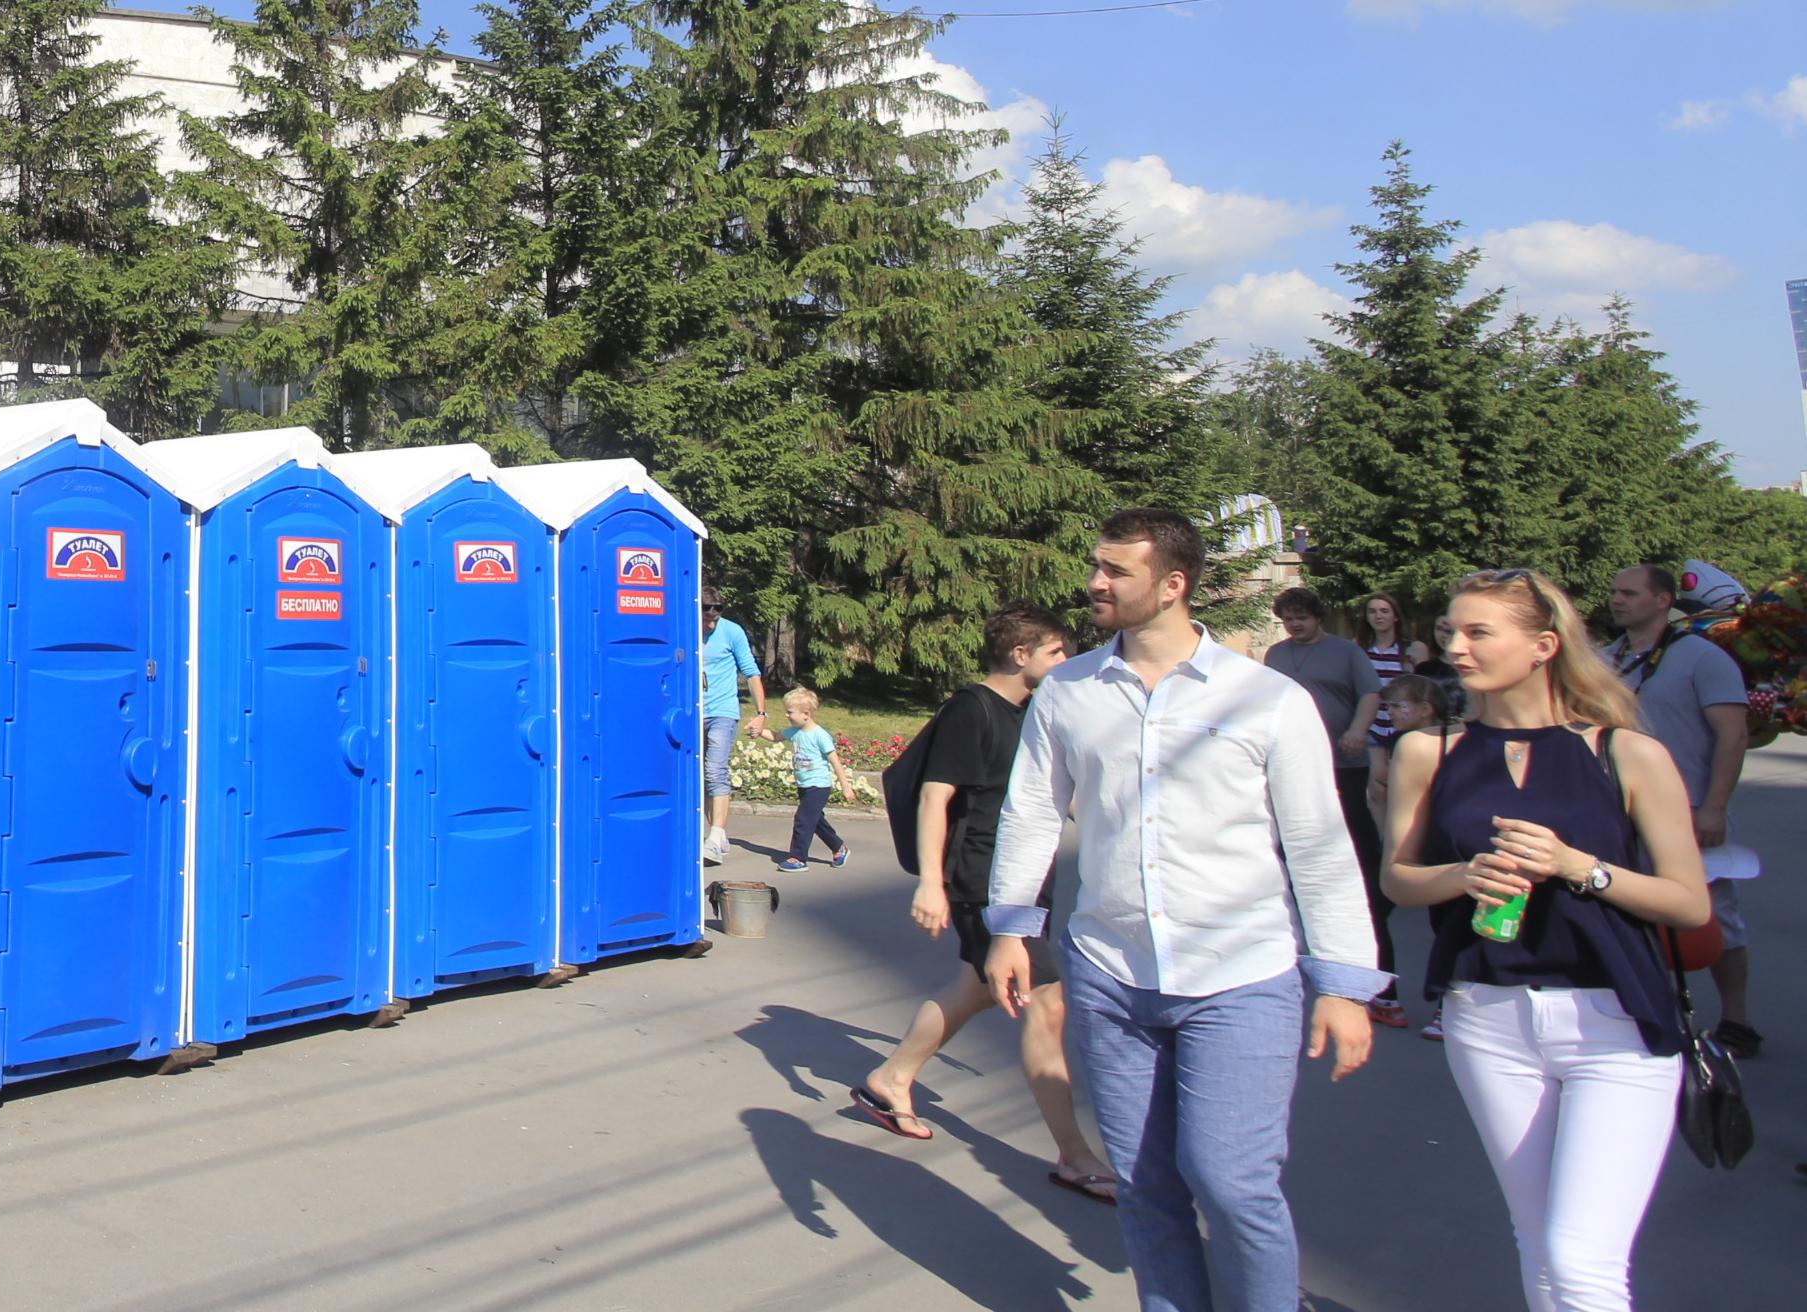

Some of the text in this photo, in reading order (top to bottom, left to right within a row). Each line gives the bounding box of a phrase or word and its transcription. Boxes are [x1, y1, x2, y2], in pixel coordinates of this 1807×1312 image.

[67, 539, 109, 555] ТУАЛЕТ
[295, 547, 329, 561] ТУАЛЕТ
[470, 549, 504, 562] ТУАЛЕТ
[281, 598, 338, 612] БЕСПЛАТНО
[621, 596, 662, 609] БЕСПЛАТНО
